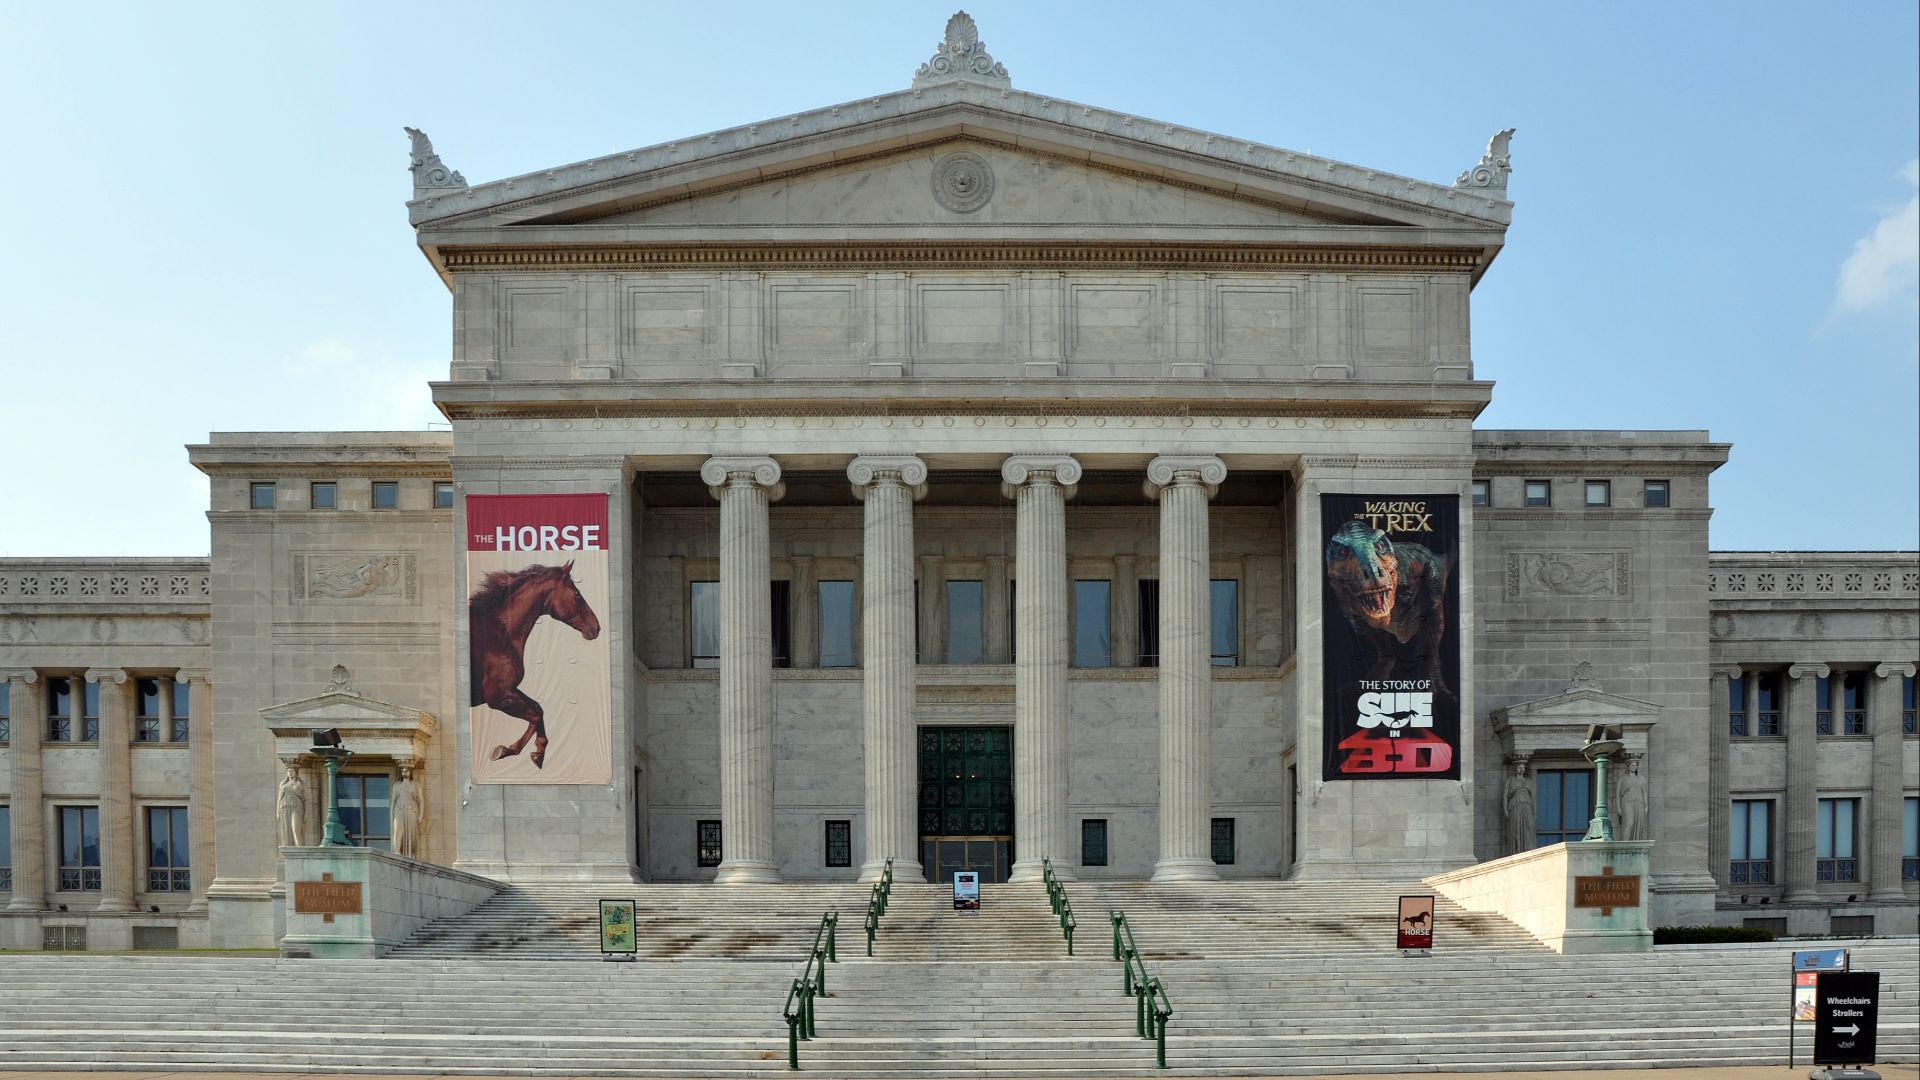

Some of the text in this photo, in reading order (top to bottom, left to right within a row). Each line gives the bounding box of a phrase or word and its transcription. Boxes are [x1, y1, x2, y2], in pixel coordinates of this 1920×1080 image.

[1365, 502, 1426, 513] WAKING
[1386, 513, 1433, 535] REX
[474, 525, 600, 551] THE HORSE
[1359, 680, 1431, 690] THE STORY OF
[1357, 692, 1433, 728] SUE
[1583, 881, 1635, 891] THE FIELD
[302, 887, 355, 897] THE FIELD
[1584, 893, 1630, 901] MUSEUM
[304, 898, 351, 908] MUSEUM
[1827, 997, 1871, 1005] Wheelchairs
[1832, 1009, 1864, 1017] Strollers
